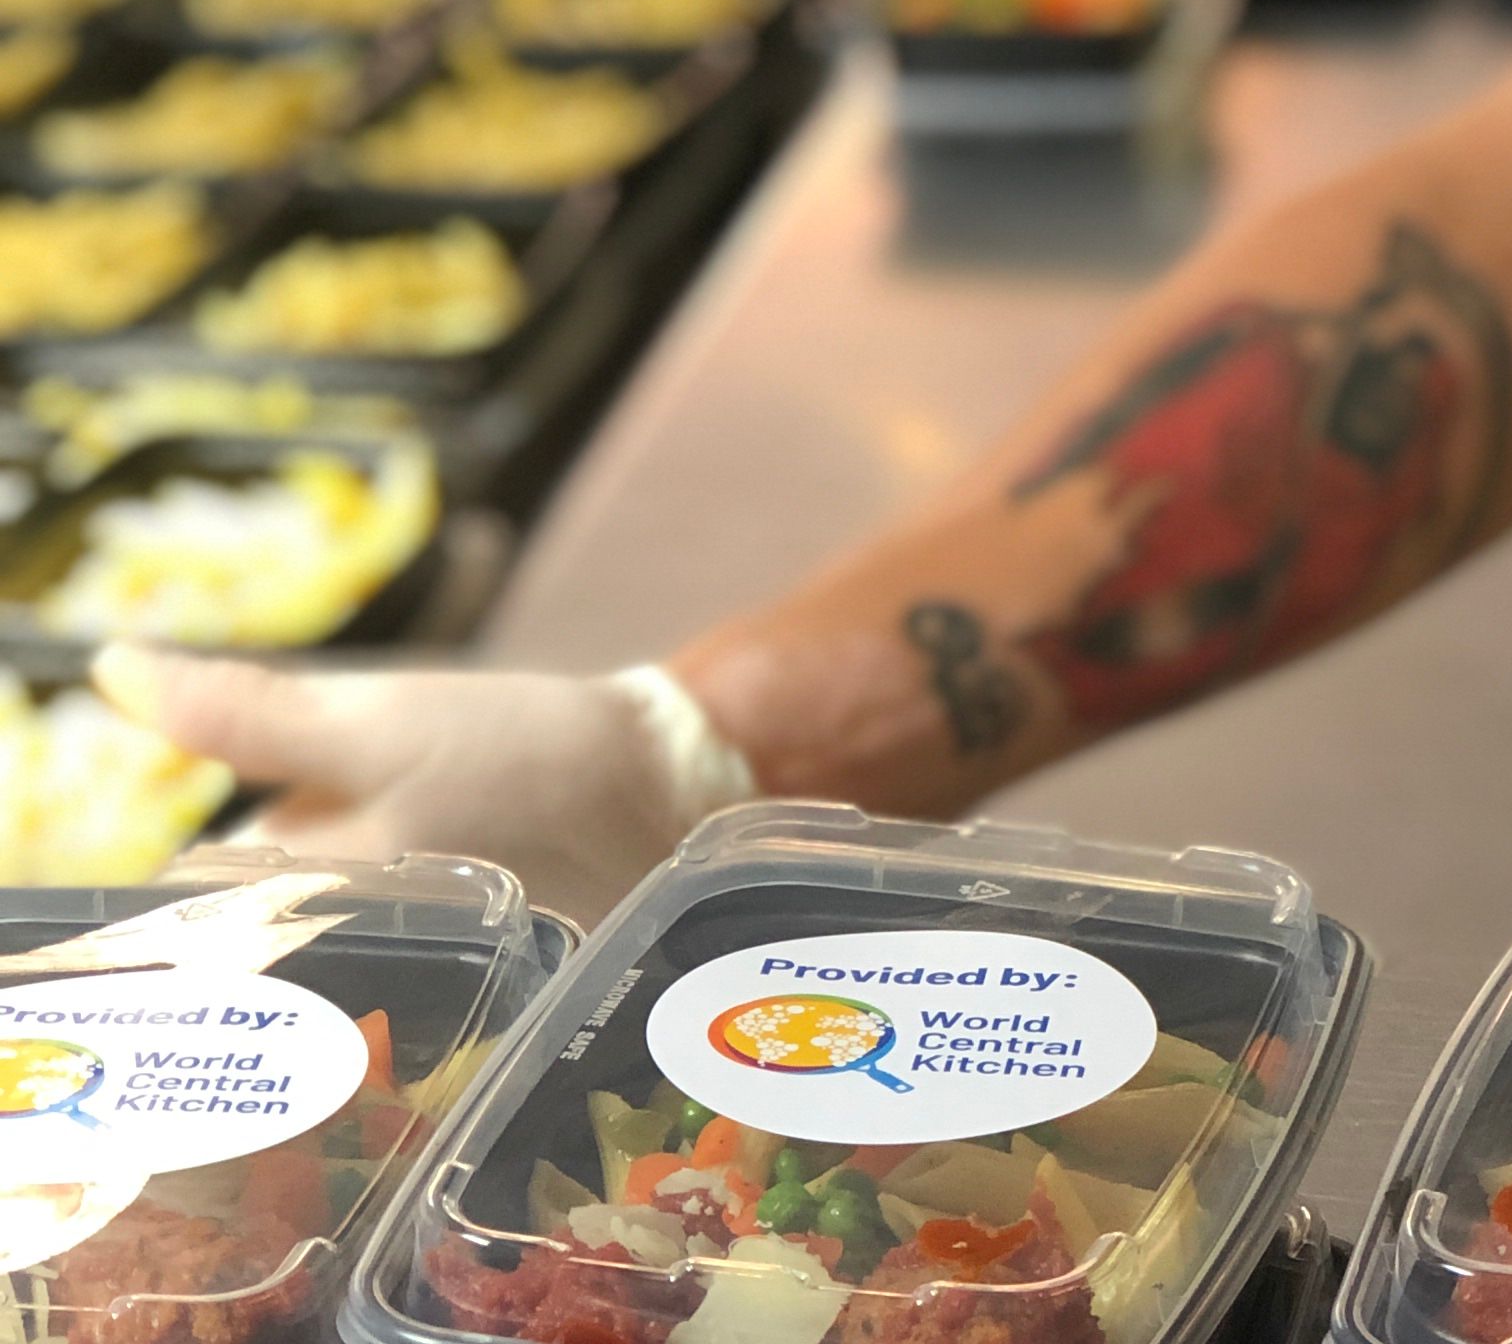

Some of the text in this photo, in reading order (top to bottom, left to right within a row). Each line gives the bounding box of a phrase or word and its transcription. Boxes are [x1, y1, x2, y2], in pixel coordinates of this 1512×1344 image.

[761, 958, 1078, 990] Provided by:
[219, 1007, 299, 1031] by:
[559, 968, 644, 1061] MICROWAVE SAFE
[921, 1010, 1050, 1033] World
[917, 1033, 1083, 1057] Central
[134, 1051, 264, 1071] World
[911, 1054, 1086, 1079] Kitchen
[126, 1072, 292, 1093] Central
[114, 1094, 290, 1115] Kitchen
